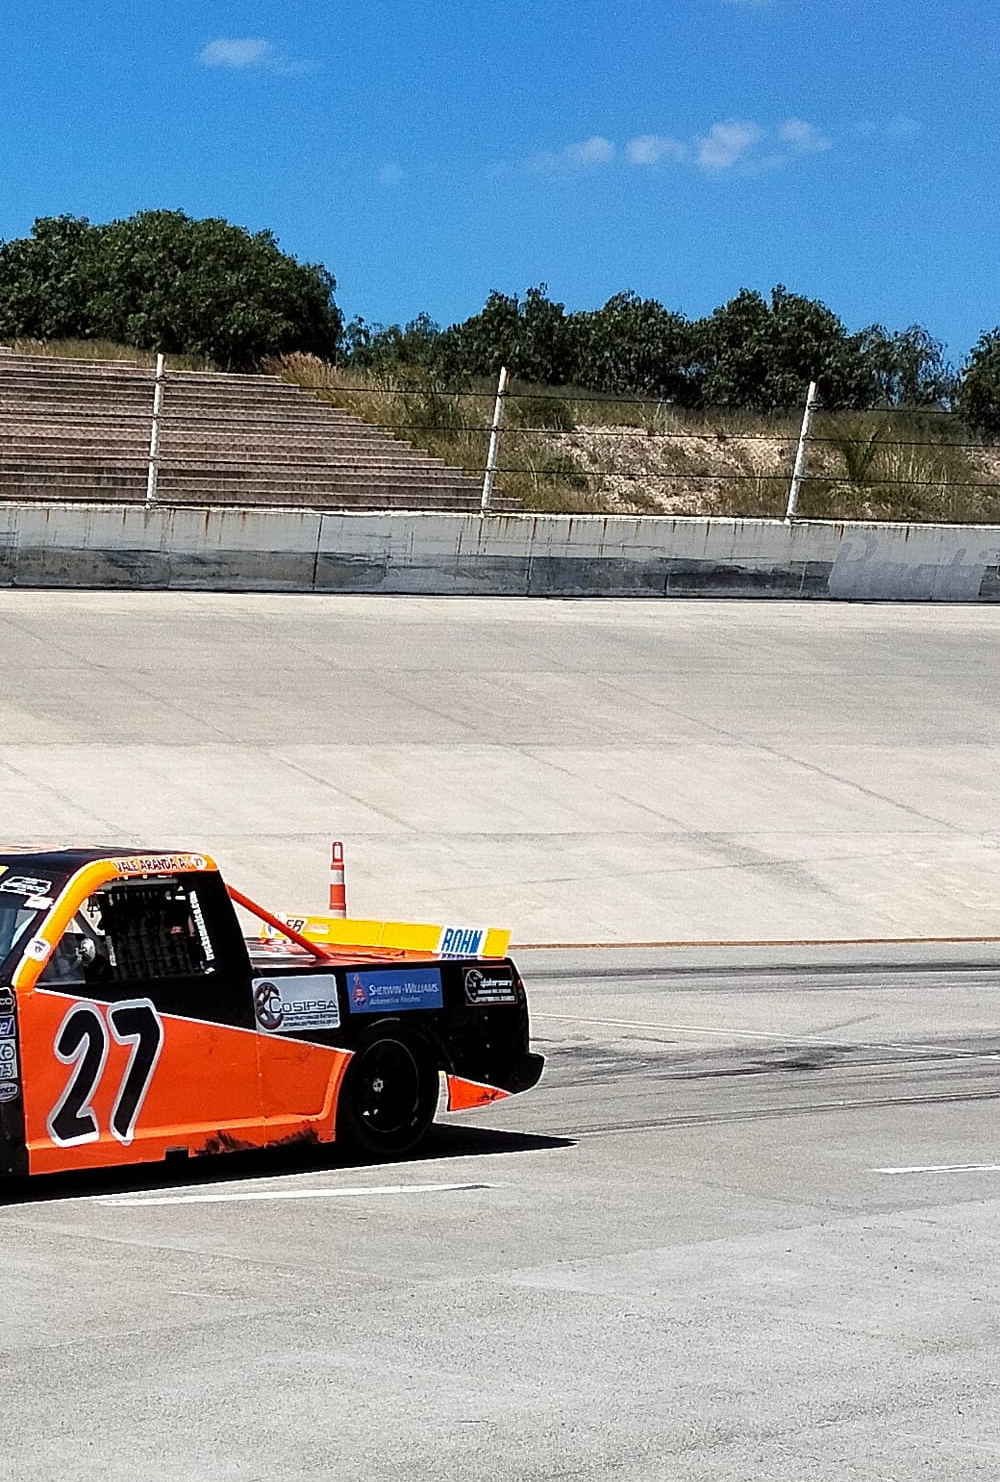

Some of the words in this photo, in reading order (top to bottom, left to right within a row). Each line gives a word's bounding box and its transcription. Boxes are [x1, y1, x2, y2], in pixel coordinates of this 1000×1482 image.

[113, 860, 138, 872] VALE
[269, 996, 337, 1013] COSIPSA
[48, 1000, 163, 1145] 27
